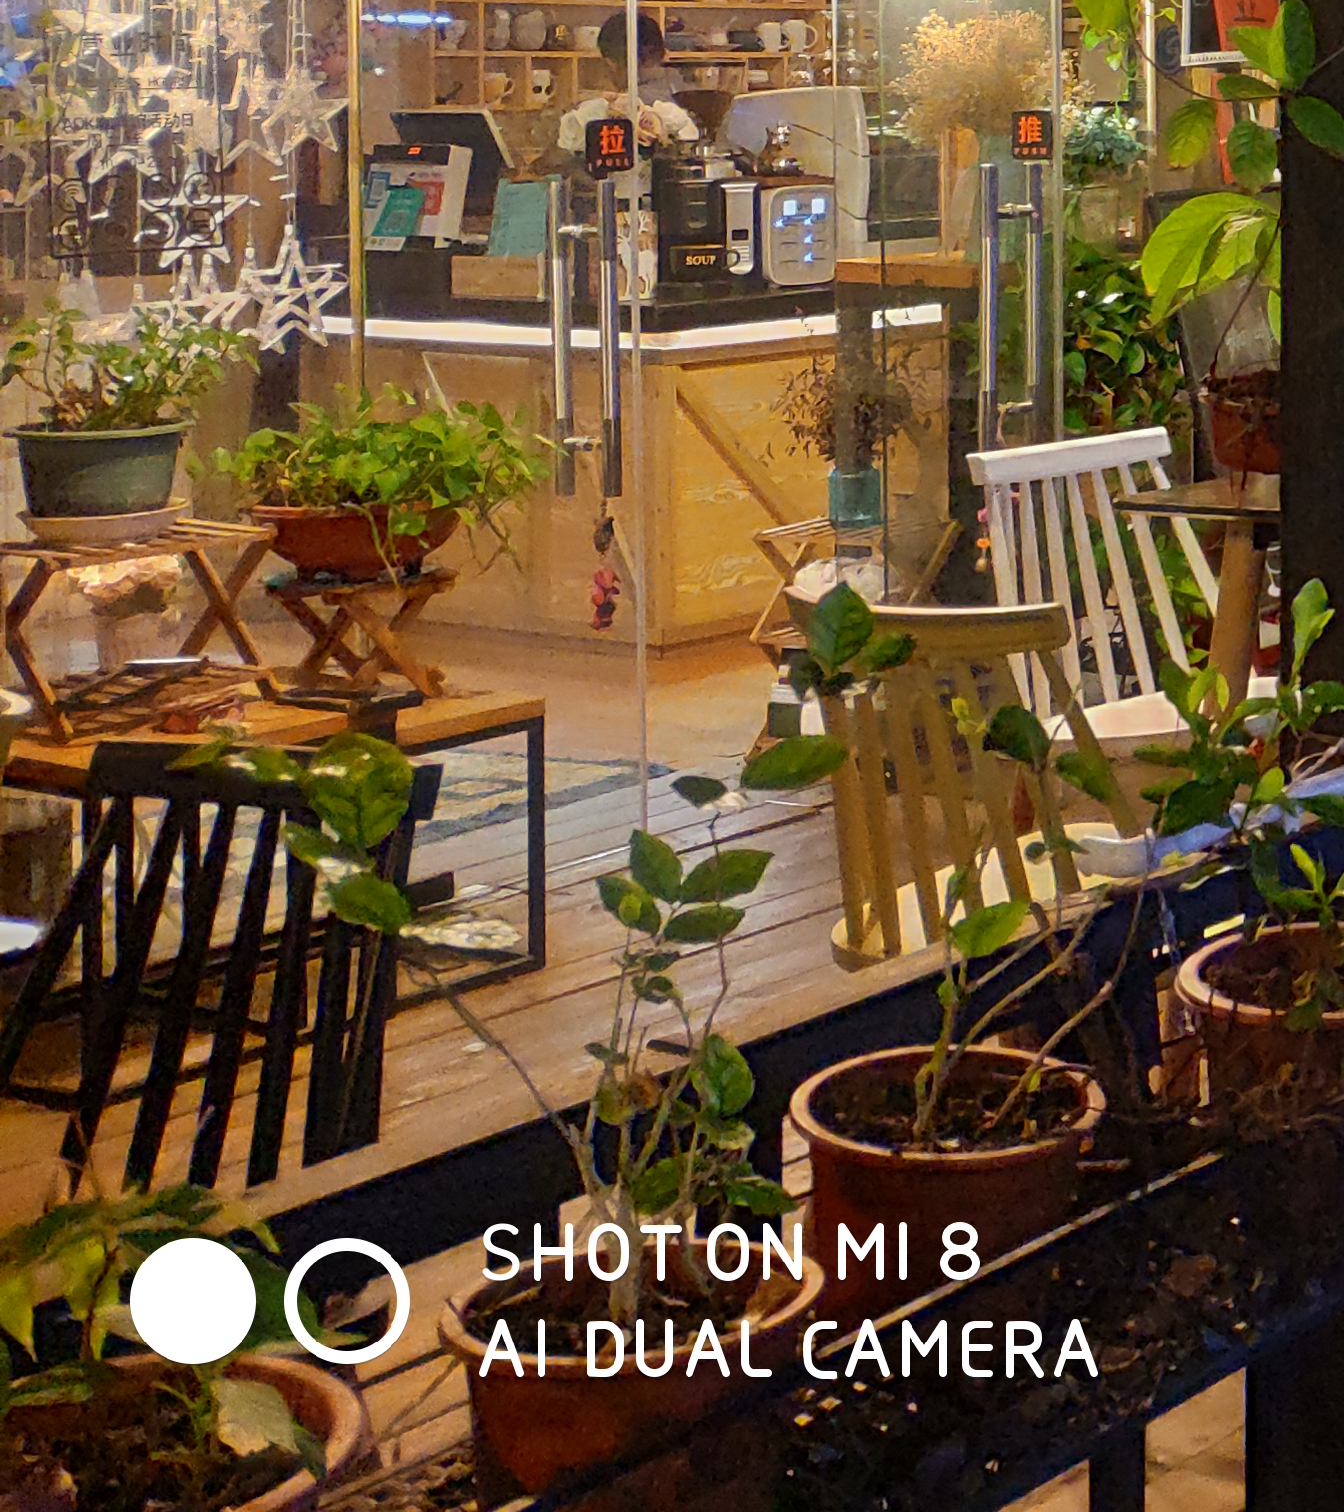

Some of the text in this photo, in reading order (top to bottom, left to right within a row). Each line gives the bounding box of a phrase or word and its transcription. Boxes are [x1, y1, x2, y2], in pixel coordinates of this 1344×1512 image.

[599, 124, 627, 155] 拉
[1017, 115, 1043, 144] 推
[685, 254, 717, 266] SOUP
